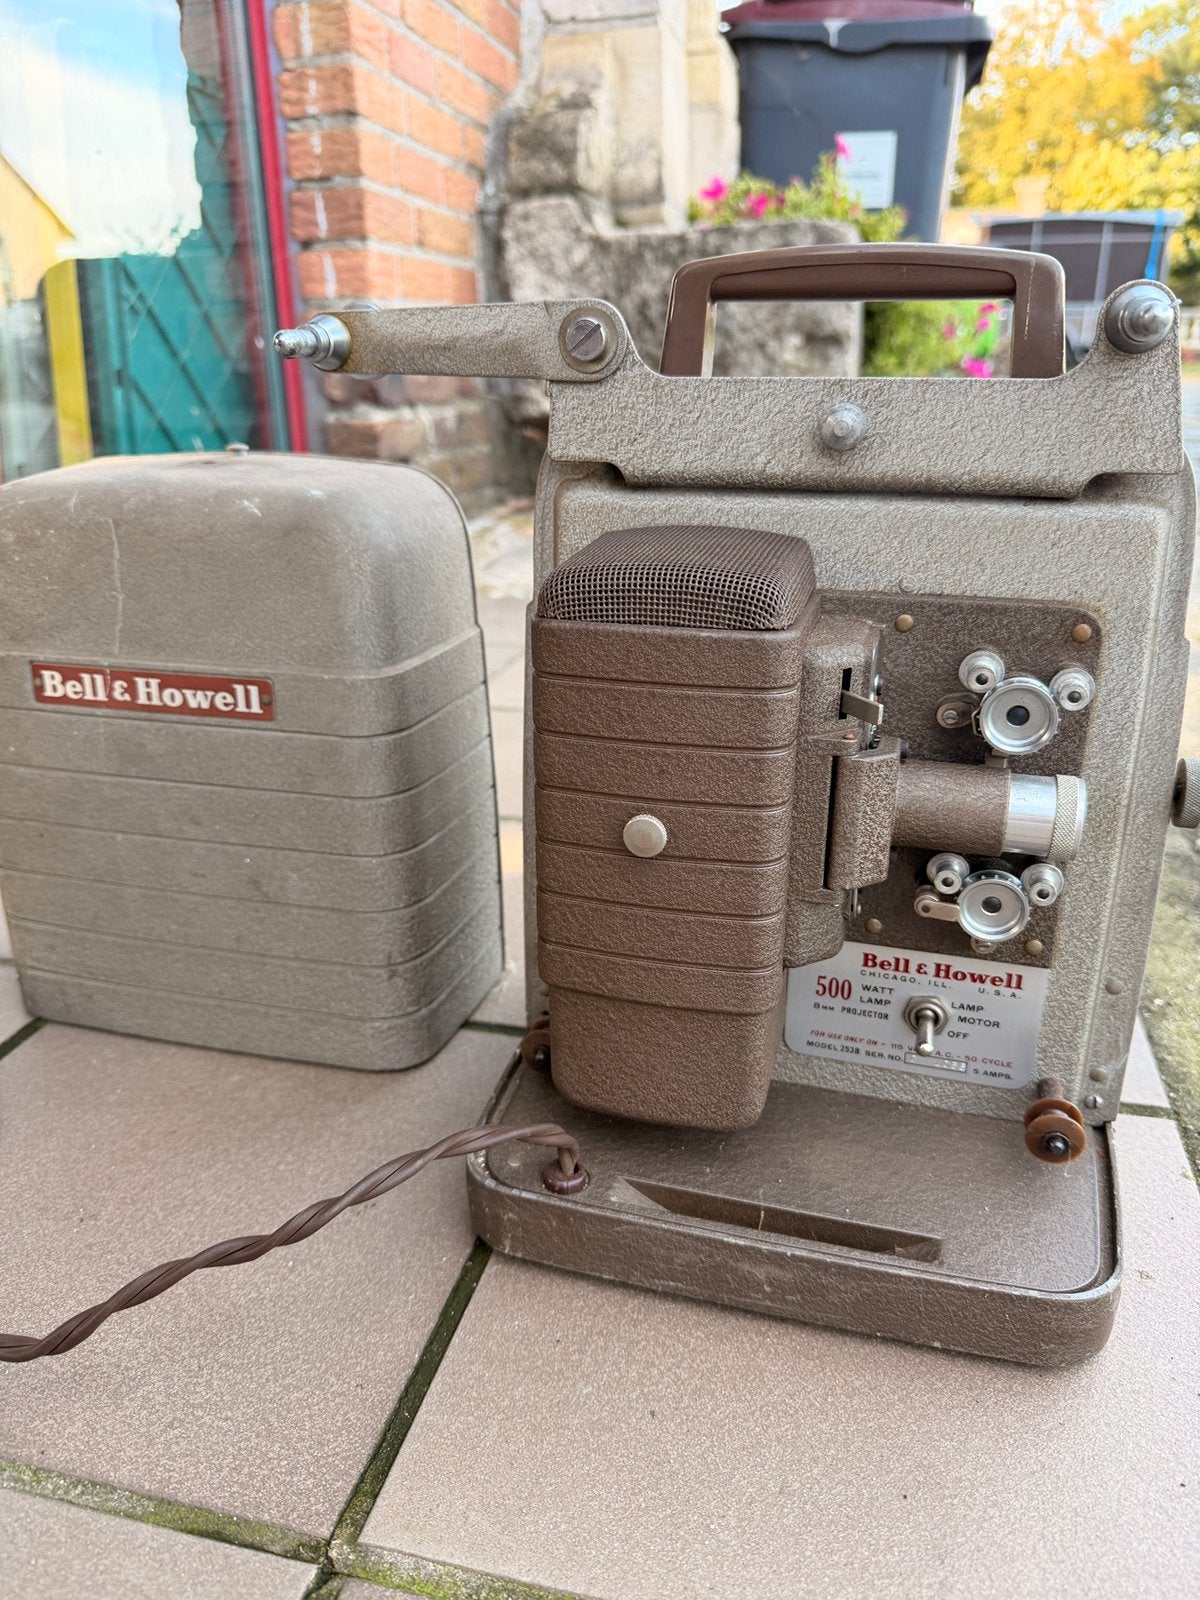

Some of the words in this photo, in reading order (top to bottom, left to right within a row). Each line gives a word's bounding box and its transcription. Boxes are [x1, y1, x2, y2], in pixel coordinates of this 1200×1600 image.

[39, 669, 108, 701] Bell
[112, 680, 131, 701] &
[134, 677, 263, 713] Howell
[862, 953, 910, 974] Bell
[916, 963, 928, 974] &
[934, 963, 1023, 989] Howell
[816, 975, 852, 1000] 500
[861, 984, 895, 994] WATT
[928, 980, 952, 989] ILL.
[860, 996, 891, 1006] LAMP
[951, 1002, 984, 1012] LAMP
[841, 1006, 888, 1020] PROJECTOR
[958, 1016, 1000, 1028] MOTOR
[947, 1031, 969, 1039] OFF
[806, 1040, 839, 1050] MODEL
[865, 1050, 886, 1058] SER.
[983, 1070, 1013, 1080] AMPS.
[981, 1058, 1012, 1067] CYCLE
